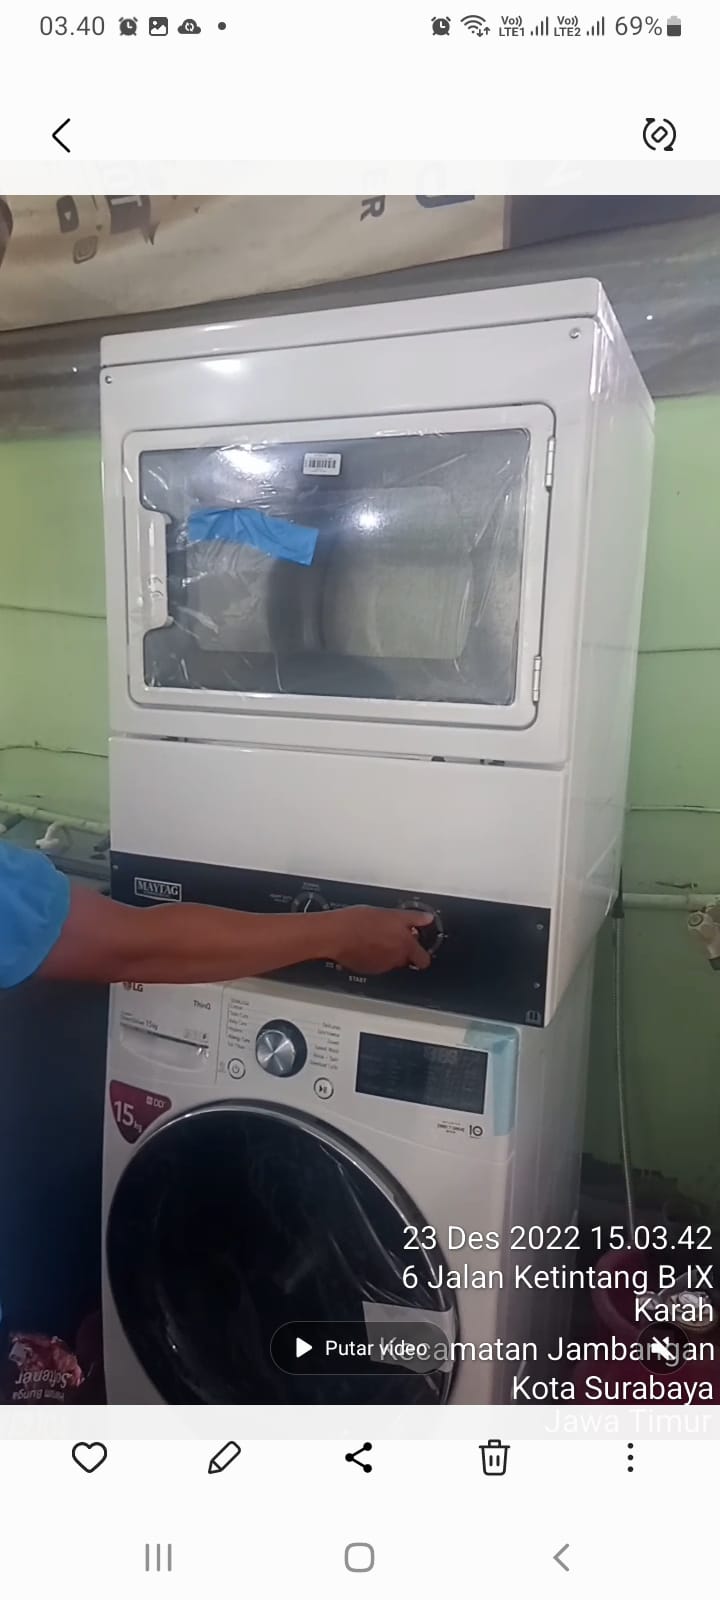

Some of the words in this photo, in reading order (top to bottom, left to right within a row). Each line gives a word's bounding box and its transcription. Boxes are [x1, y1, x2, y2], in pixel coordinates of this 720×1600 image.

[137, 880, 179, 896] MAYTAG
[133, 983, 144, 992] LG
[193, 1000, 212, 1010] ThinQ
